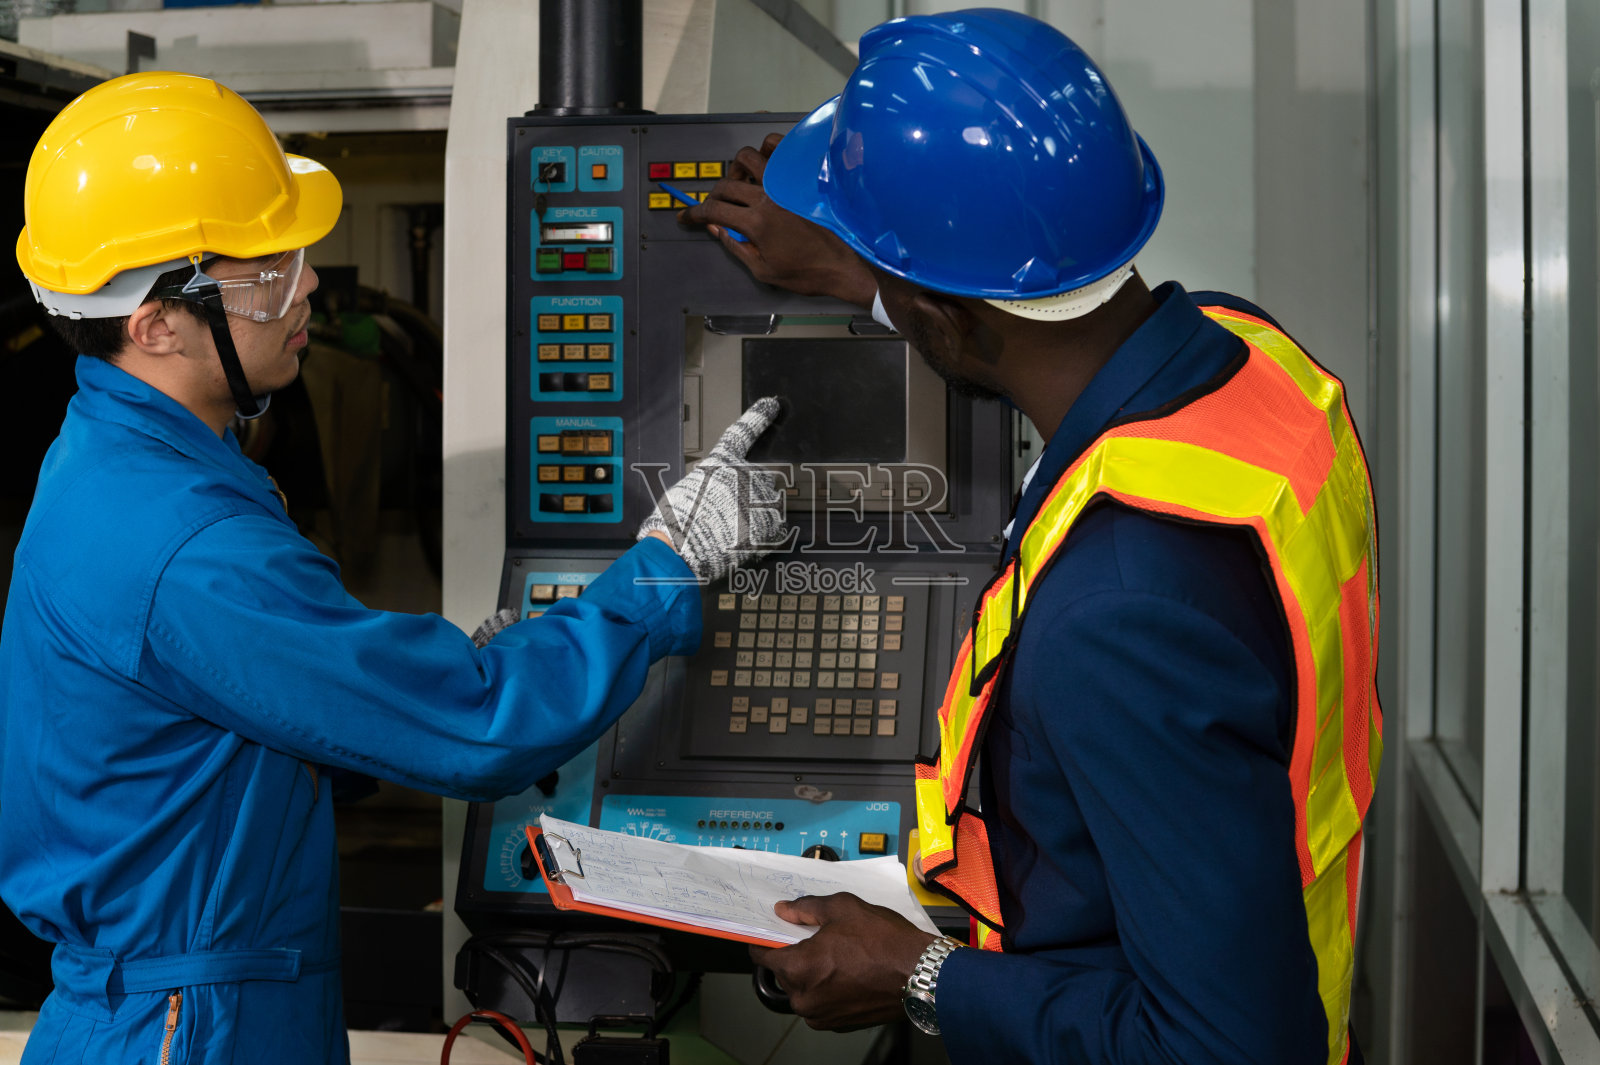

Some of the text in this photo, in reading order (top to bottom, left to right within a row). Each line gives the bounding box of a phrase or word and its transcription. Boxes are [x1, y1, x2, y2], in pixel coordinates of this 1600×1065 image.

[543, 149, 562, 157] KEY
[581, 148, 620, 156] CAUTION
[555, 209, 598, 217] SPINDLE
[551, 298, 602, 306] FUNCTION
[556, 419, 597, 427] MANUAL
[866, 803, 889, 811] JOG
[709, 810, 774, 820] REFERENCE
